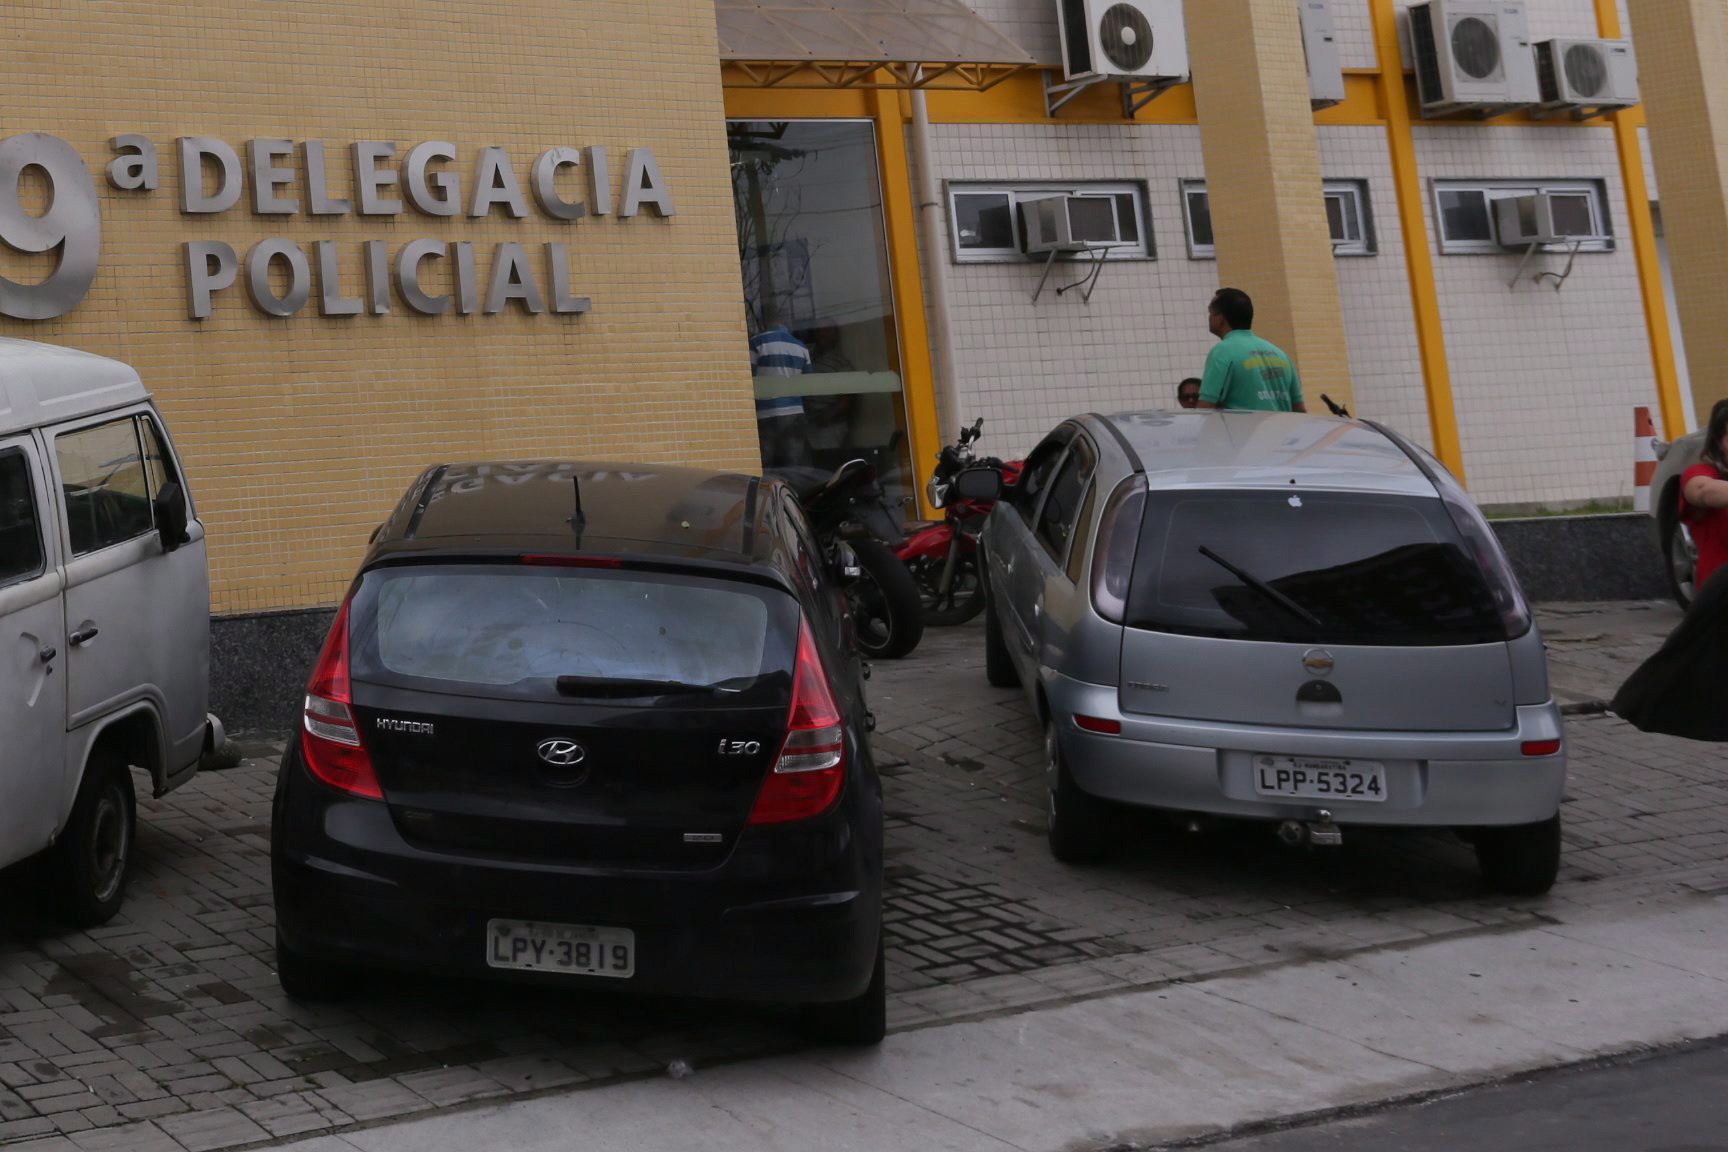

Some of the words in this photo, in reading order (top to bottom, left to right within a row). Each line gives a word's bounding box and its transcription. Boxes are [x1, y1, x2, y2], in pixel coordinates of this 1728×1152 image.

[174, 136, 674, 220] DELEGACIA
[183, 237, 592, 320] POLICIAL
[376, 717, 434, 735] HYUNDAI
[718, 738, 760, 755] i30
